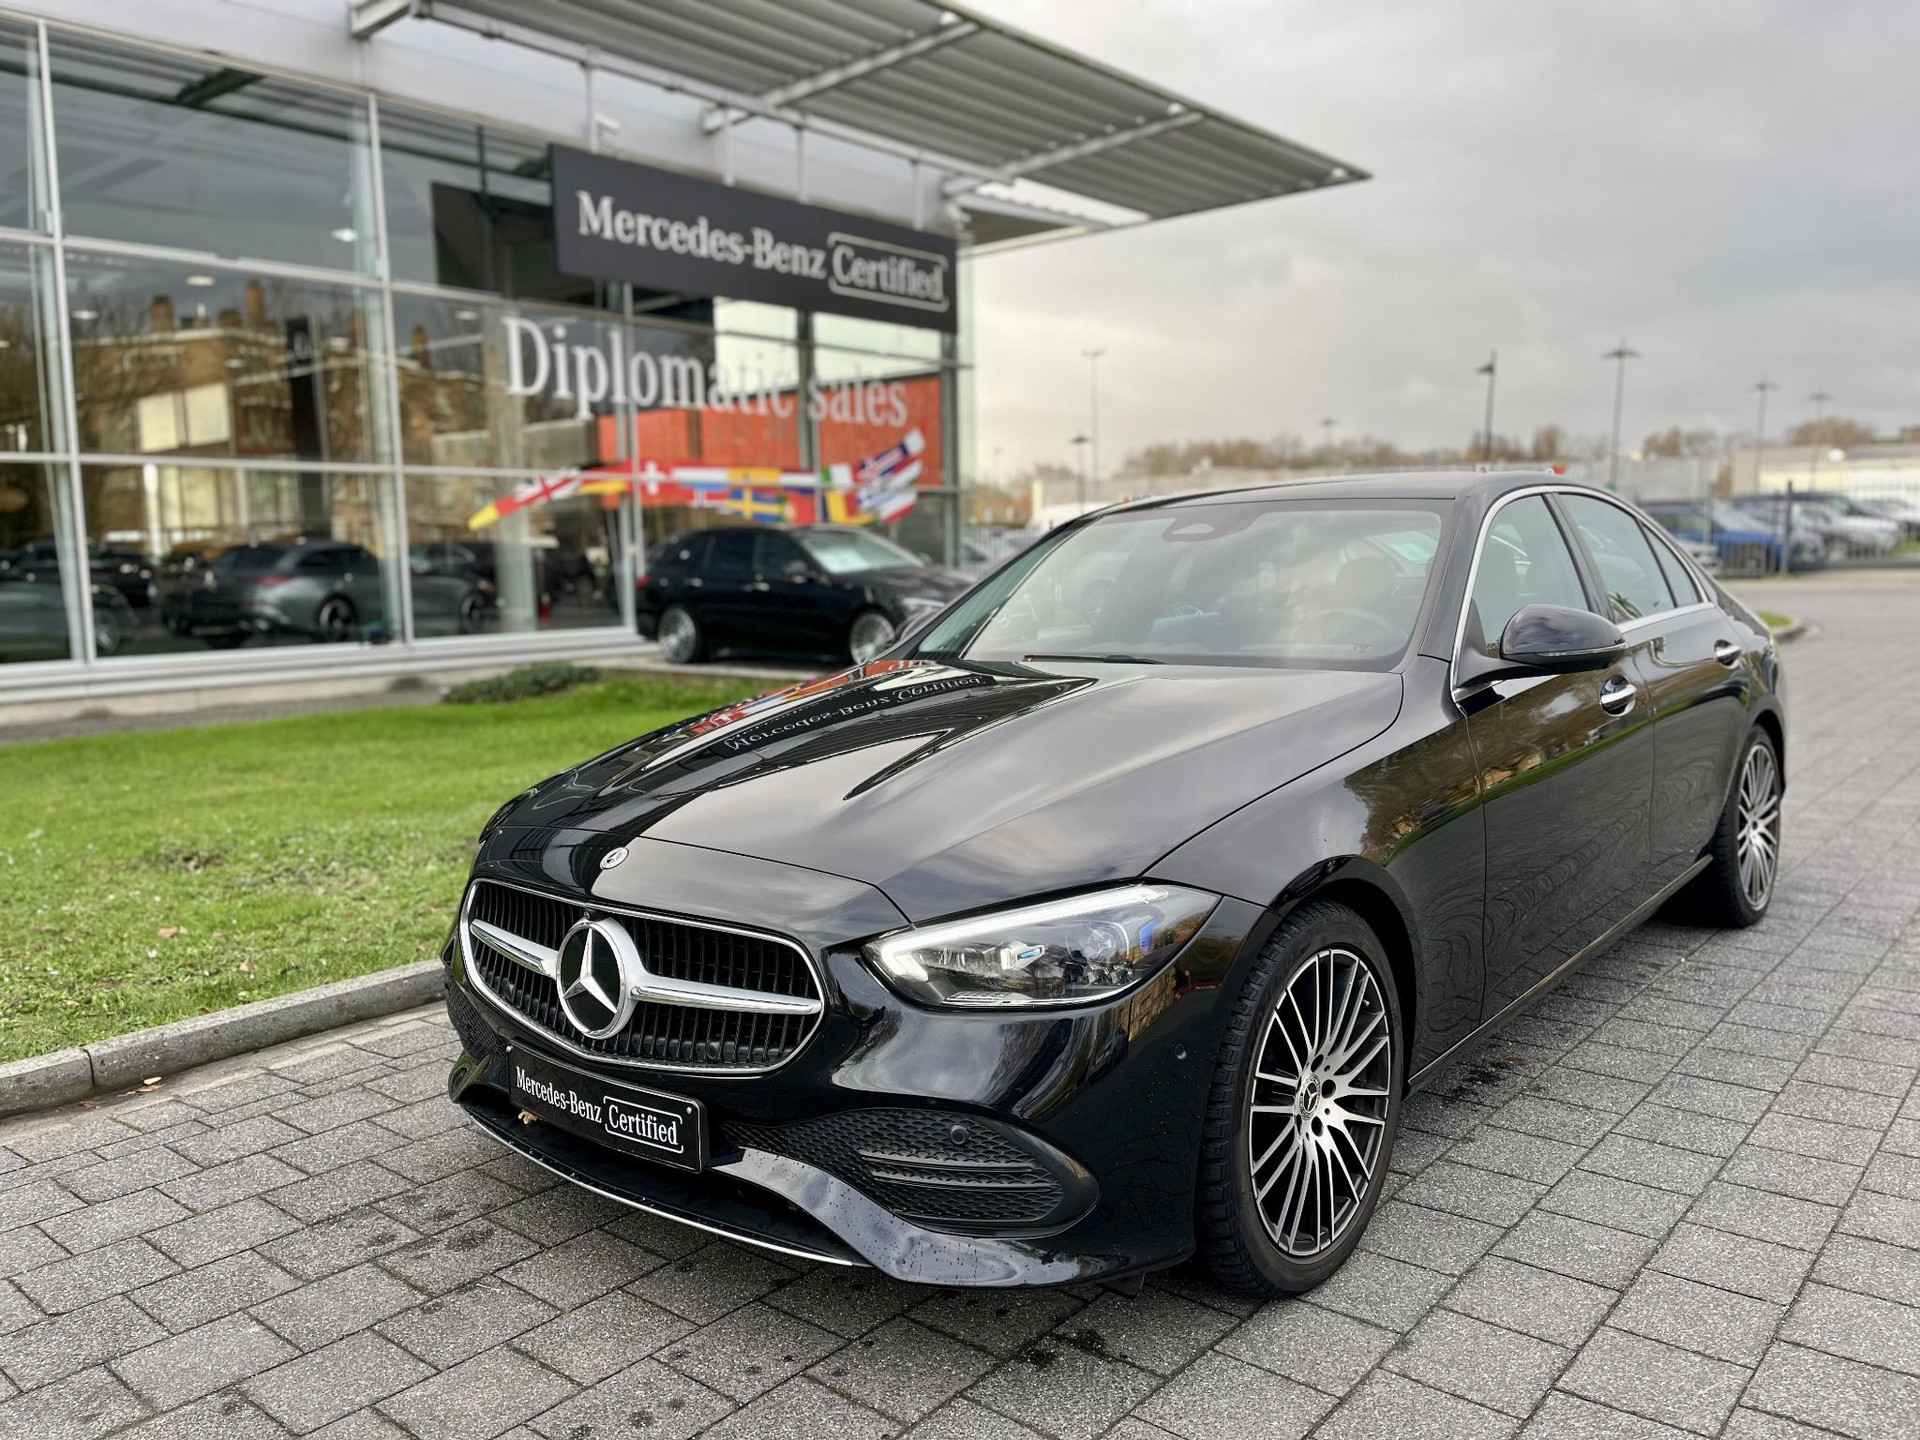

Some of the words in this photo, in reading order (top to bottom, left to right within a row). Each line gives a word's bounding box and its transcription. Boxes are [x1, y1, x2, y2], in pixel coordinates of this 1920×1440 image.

[576, 190, 828, 280] Mercedes-Benz
[831, 245, 944, 300] Certified
[503, 316, 794, 421] Diplomatic
[808, 365, 907, 428] sales
[516, 1066, 602, 1124] Mercedes-Benz
[608, 1104, 679, 1146] Certified
